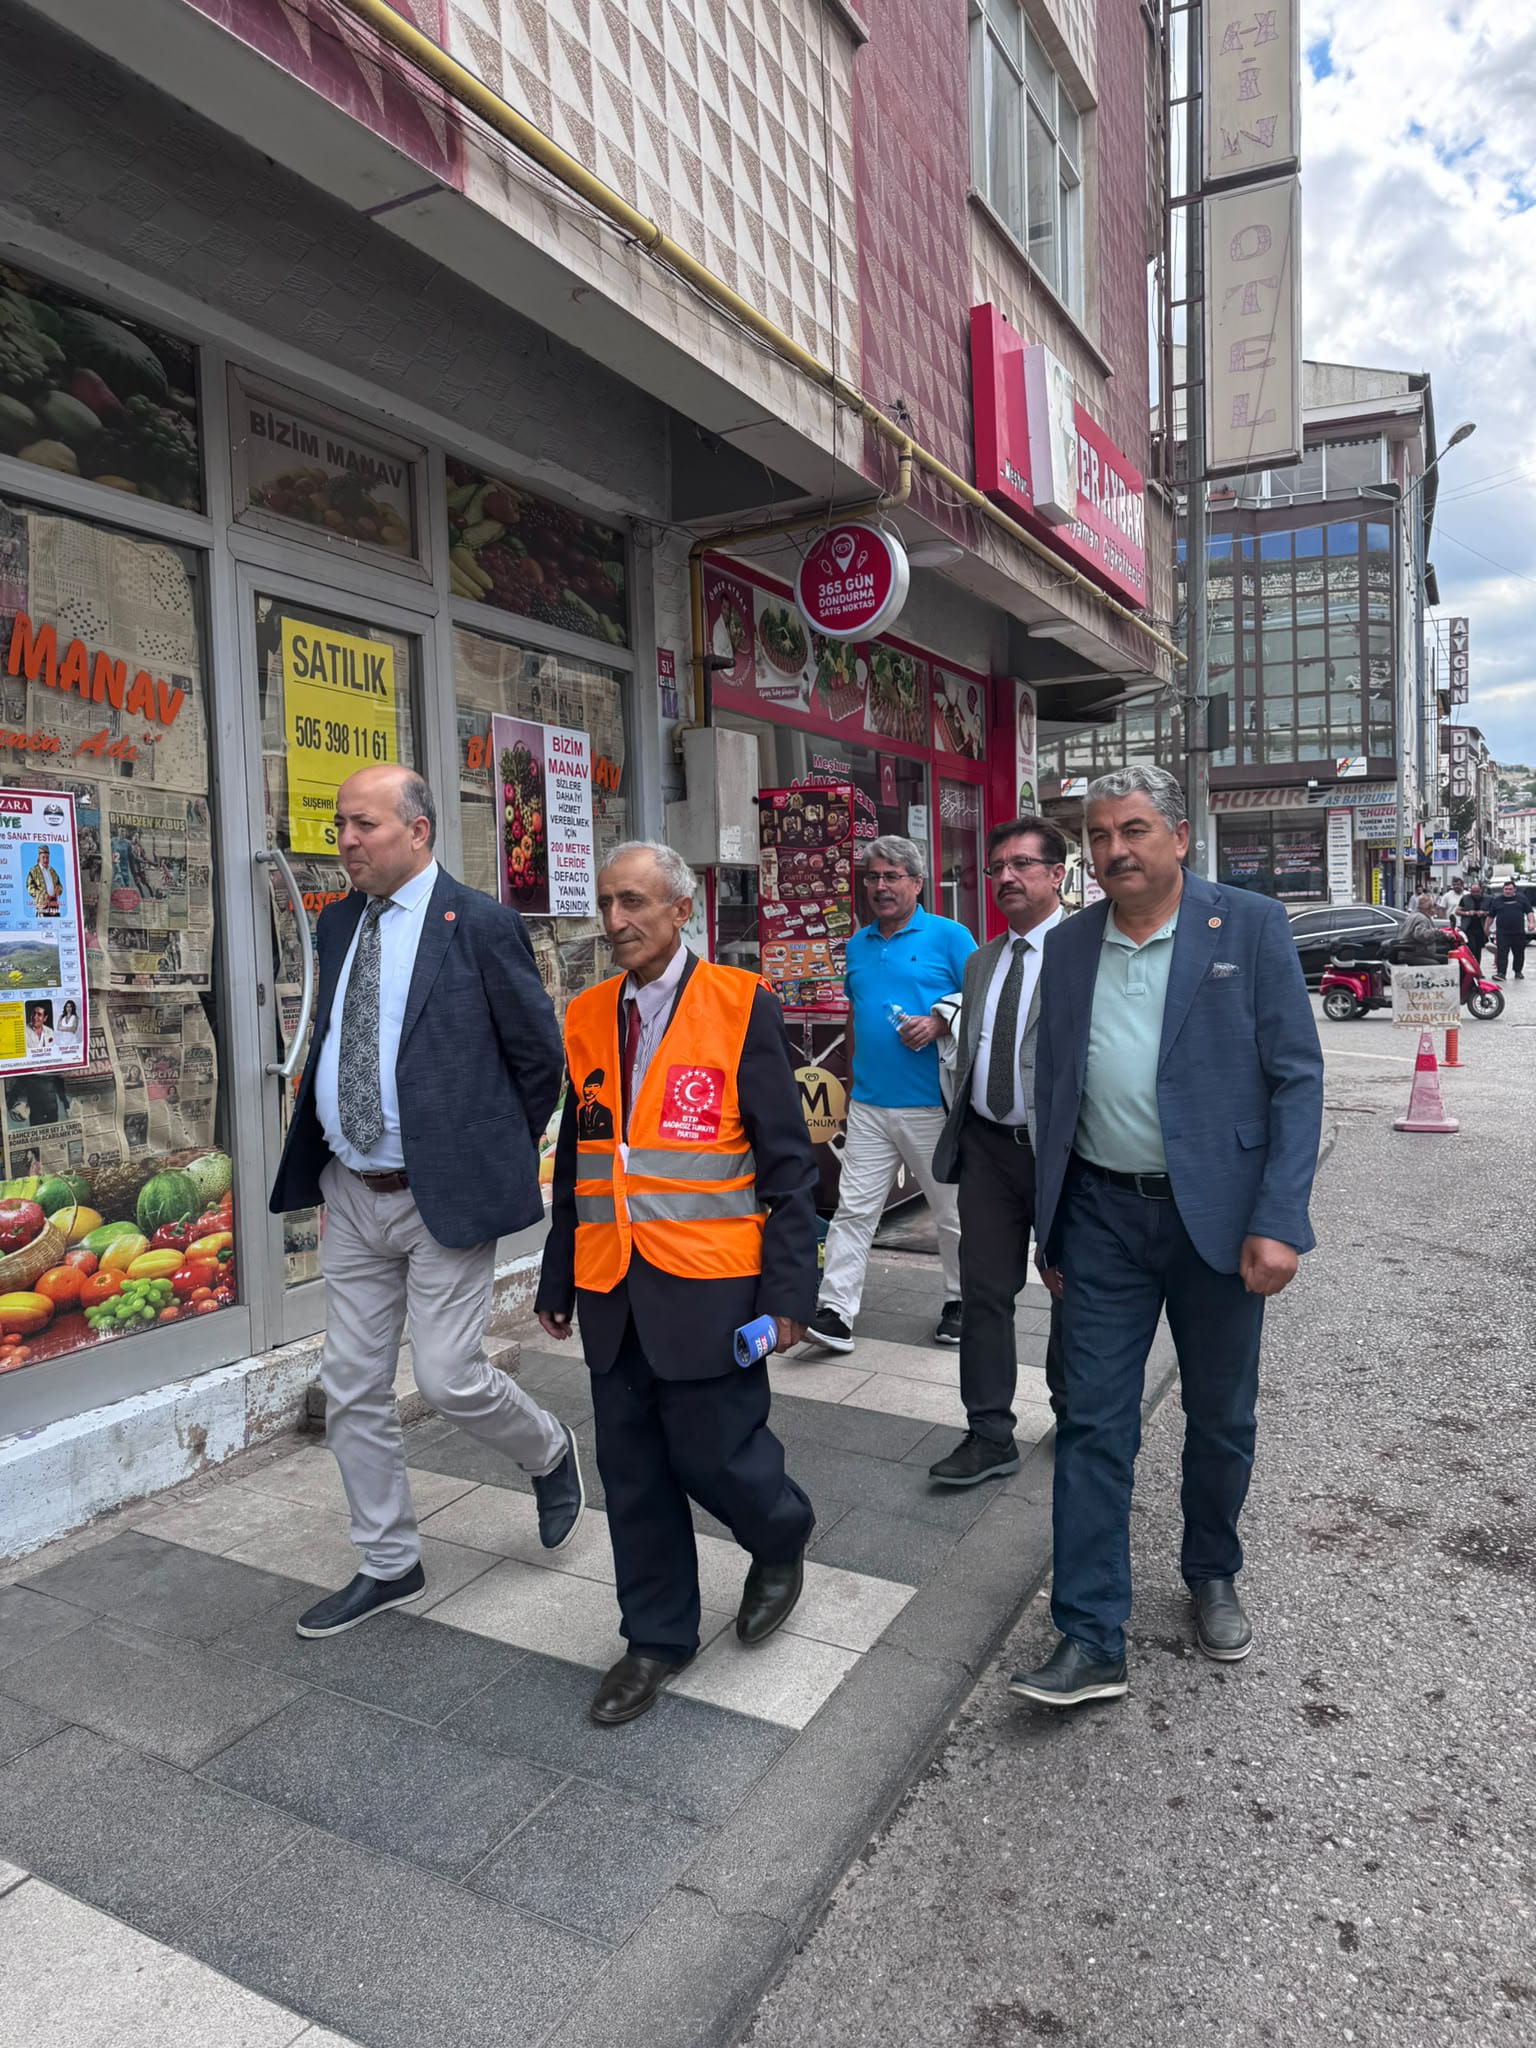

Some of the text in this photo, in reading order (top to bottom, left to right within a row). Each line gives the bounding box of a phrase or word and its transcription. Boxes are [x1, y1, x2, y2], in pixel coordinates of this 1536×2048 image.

[1222, 224, 1279, 429] OTEL
[250, 410, 404, 489] BİZİM MANAV
[1103, 461, 1145, 553] AYBAK
[818, 573, 874, 597] 365 GÜN
[818, 588, 875, 608] DONDURMA
[820, 600, 875, 618] SATIŞ NOKTASI
[7, 610, 186, 727] MANAV
[291, 634, 388, 697] SATILIK
[295, 715, 388, 762] 505 398 11 61
[552, 735, 584, 756] BİZİM
[548, 758, 589, 780] MANAV
[813, 754, 851, 774] Meşhur
[555, 778, 582, 791] SİZLERE
[555, 790, 583, 803] DAHA İYİ
[1210, 787, 1305, 812] HUZUR
[1342, 792, 1395, 805] BAYBURT
[558, 804, 581, 815] HİZMET
[550, 814, 590, 828] VEREBİLMEK
[7, 832, 31, 841] SANAT
[32, 833, 70, 842] FESTİVALİ
[564, 827, 577, 839] İÇİN
[550, 841, 591, 855] 200 METRE
[556, 854, 586, 869] İLERİDE
[554, 870, 590, 883] DEFACTO
[558, 885, 586, 897] YANINA
[556, 900, 590, 912] TAŞINDIK
[1397, 1012, 1460, 1023] YASAKTIR
[682, 1115, 699, 1123] BTP
